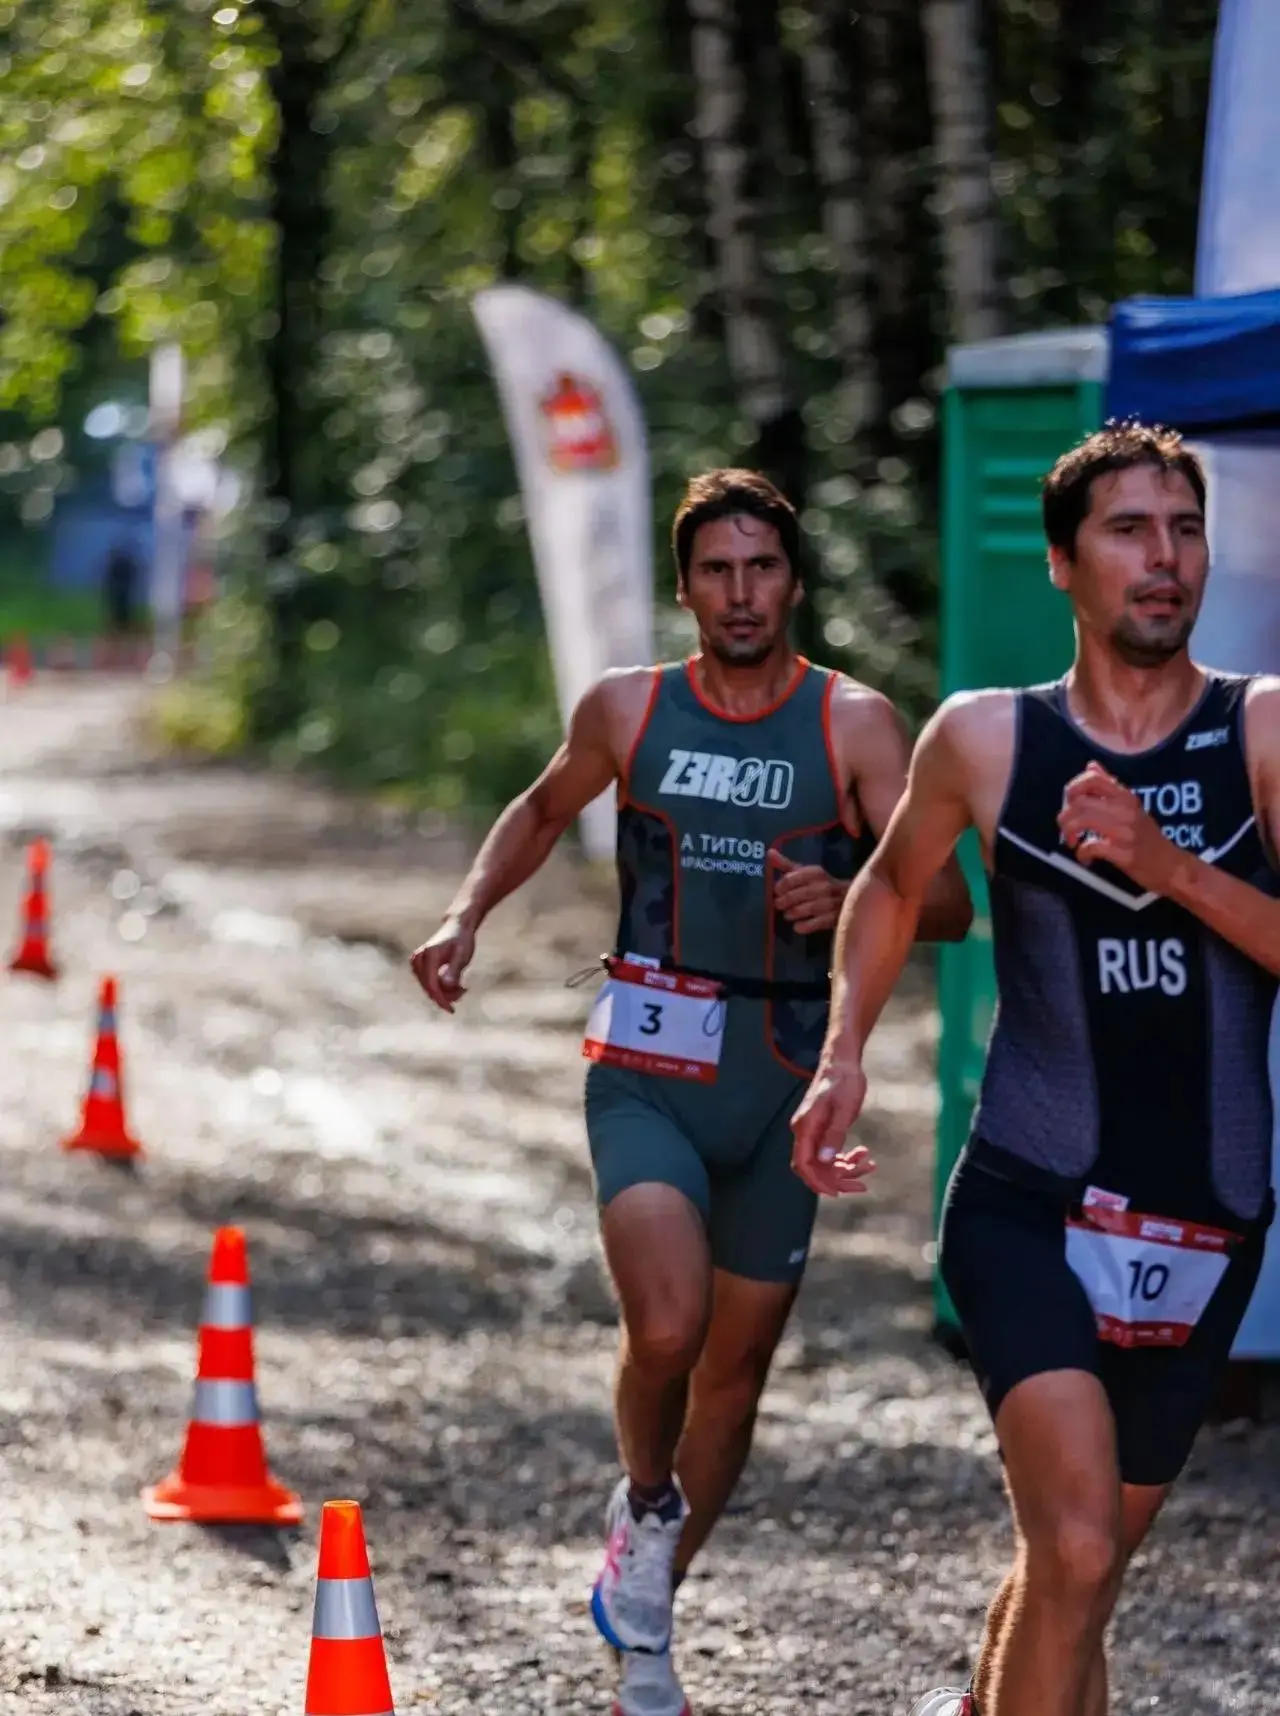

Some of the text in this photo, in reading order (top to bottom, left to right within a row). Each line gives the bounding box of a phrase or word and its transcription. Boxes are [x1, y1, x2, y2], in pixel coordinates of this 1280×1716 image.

[681, 833, 765, 859] А ТИТОВ
[1098, 938, 1187, 996] RUS
[638, 1002, 664, 1035] 3
[1128, 1261, 1169, 1301] 10
